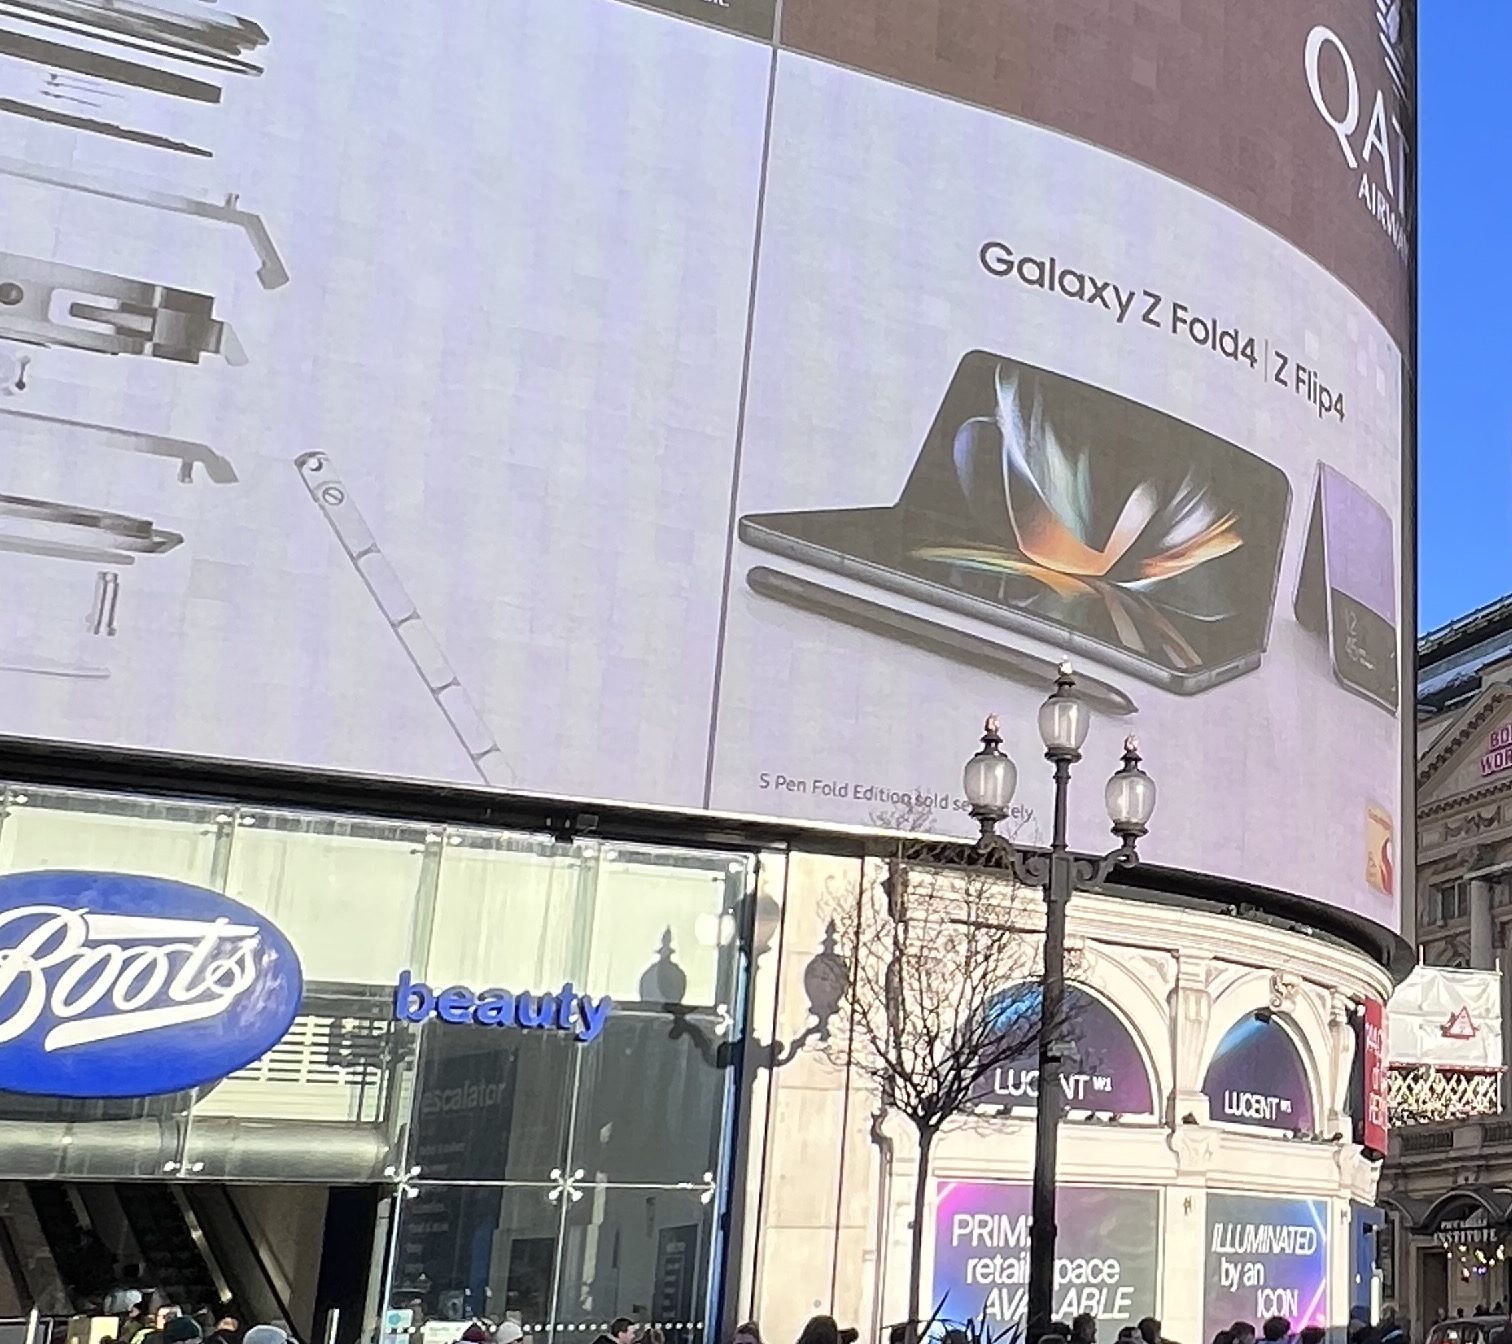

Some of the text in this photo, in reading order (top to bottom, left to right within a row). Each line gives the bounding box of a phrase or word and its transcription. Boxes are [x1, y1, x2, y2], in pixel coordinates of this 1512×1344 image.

[979, 241, 1346, 423] Galaxy Z Fold4 Z Flip4
[759, 772, 771, 790] S
[775, 775, 807, 794] Pen
[812, 779, 848, 799] Fold
[853, 784, 912, 805] Edition
[914, 792, 949, 810] sold
[0, 903, 262, 1052] Boots
[393, 969, 613, 1042] beauty
[423, 1080, 507, 1113] escalator
[994, 1068, 1113, 1101] LUCNT W1
[1224, 1090, 1279, 1120] LUCENT
[1212, 1223, 1317, 1255] ILLUMINATED
[966, 1251, 1121, 1289] retail pace
[1221, 1257, 1264, 1292] by an
[978, 1286, 1135, 1321] AVAABLE
[1256, 1288, 1298, 1319] ICON
